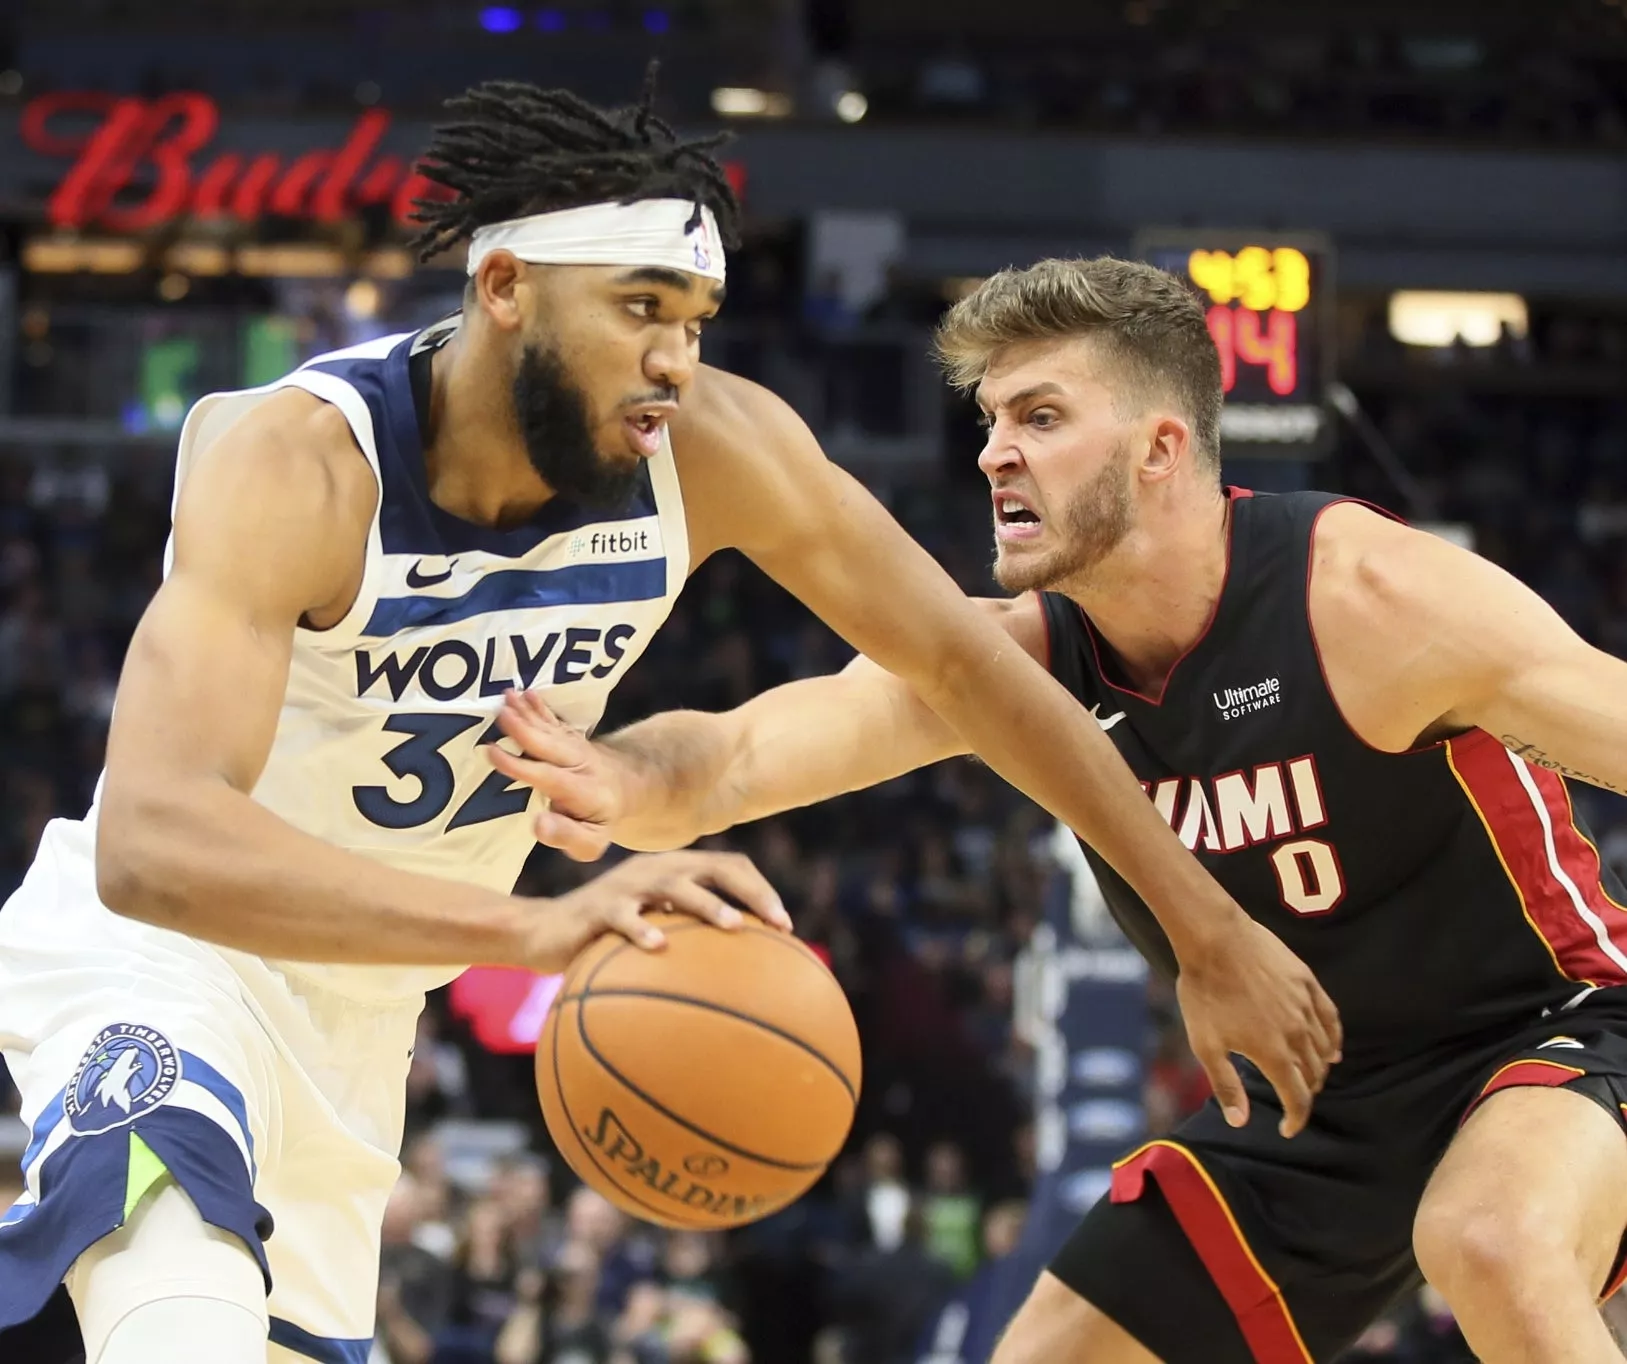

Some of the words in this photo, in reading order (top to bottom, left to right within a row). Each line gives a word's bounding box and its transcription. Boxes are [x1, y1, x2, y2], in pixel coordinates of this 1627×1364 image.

[1206, 304, 1297, 396] 14
[590, 531, 648, 554] fitbit
[354, 623, 637, 703] WOLVES
[1213, 676, 1281, 711] Ultimate
[1222, 693, 1282, 721] SOFTWARE
[352, 712, 533, 835] 32
[1138, 753, 1329, 854] IAMI
[1268, 837, 1347, 918] 0
[119, 1024, 177, 1105] TIMBERWOLVES
